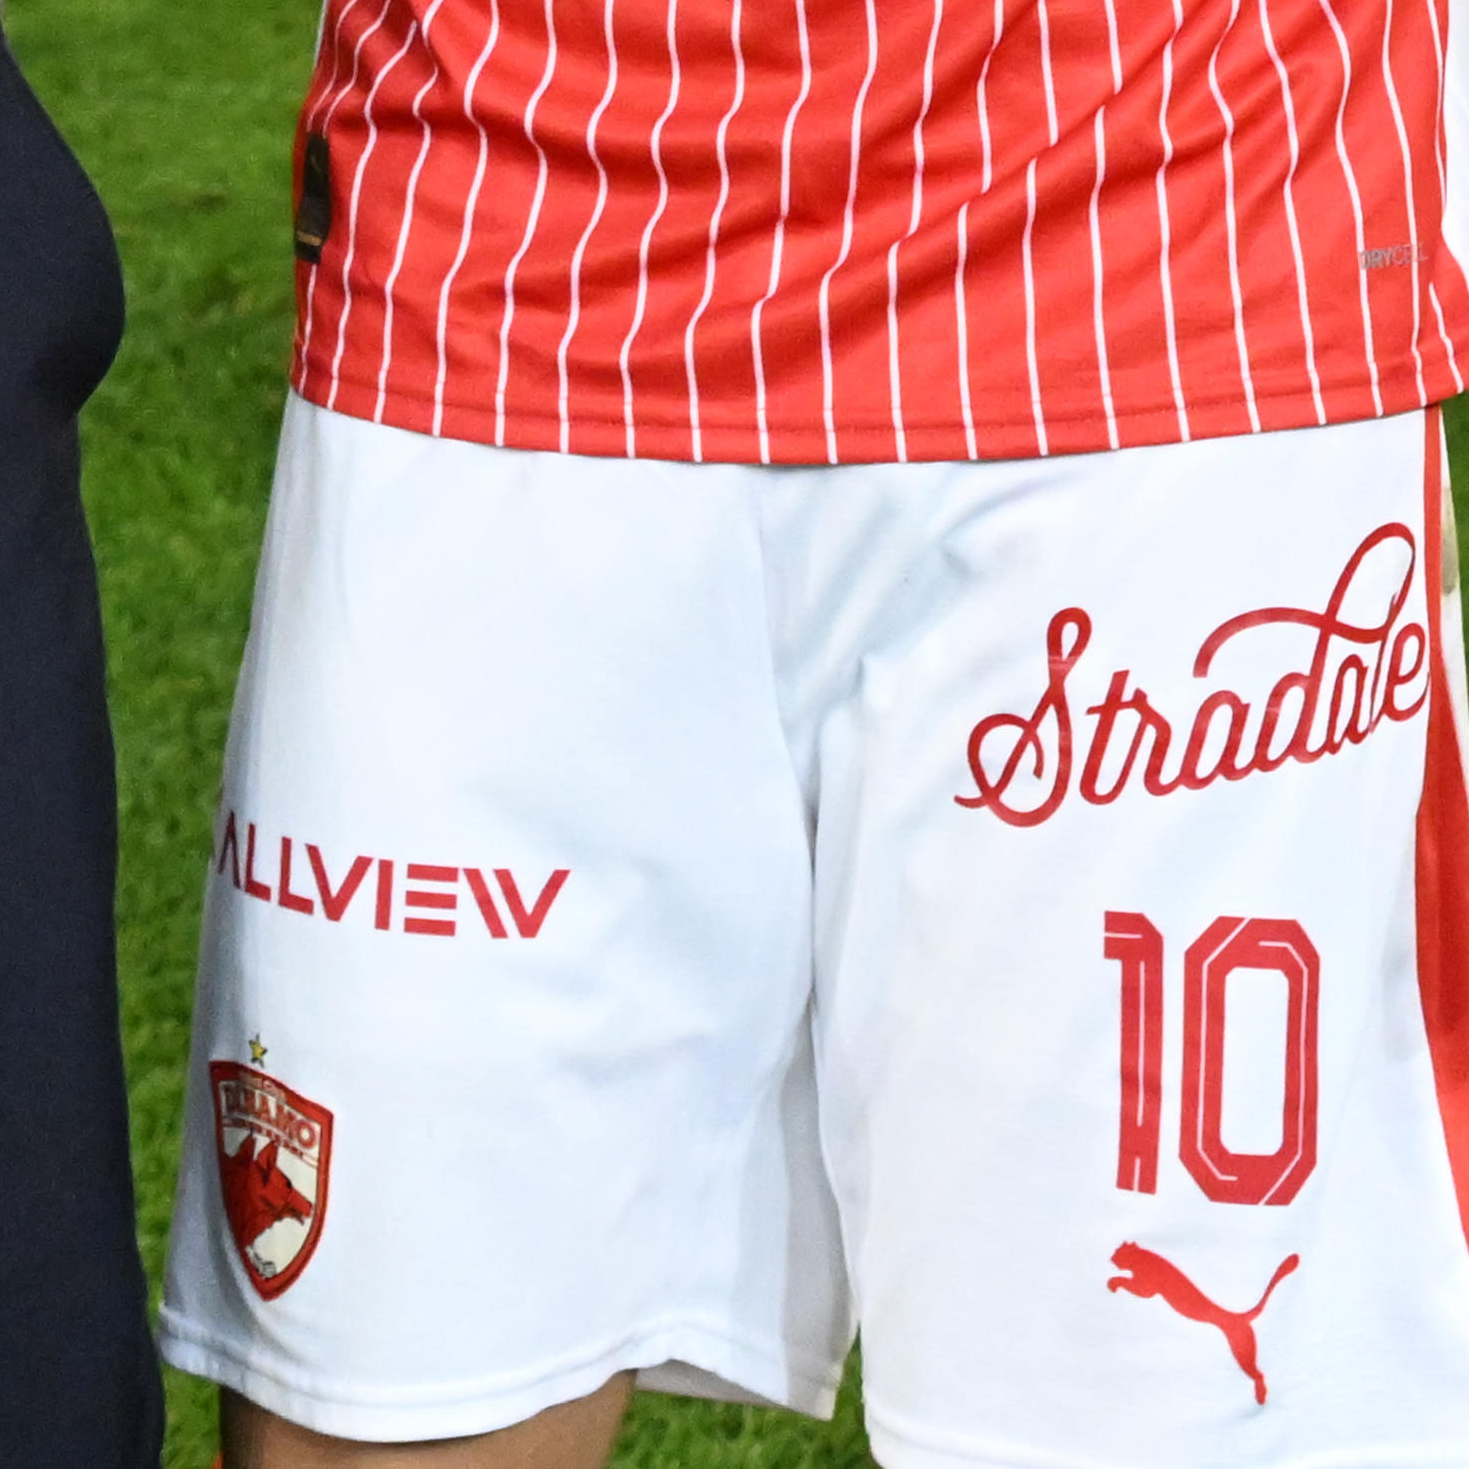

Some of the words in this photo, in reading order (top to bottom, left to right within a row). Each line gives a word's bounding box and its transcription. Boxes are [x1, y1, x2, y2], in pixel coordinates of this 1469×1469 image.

[953, 521, 1430, 828] Stradale
[218, 810, 572, 939] ALLVIEW
[1103, 910, 1321, 1206] 10
